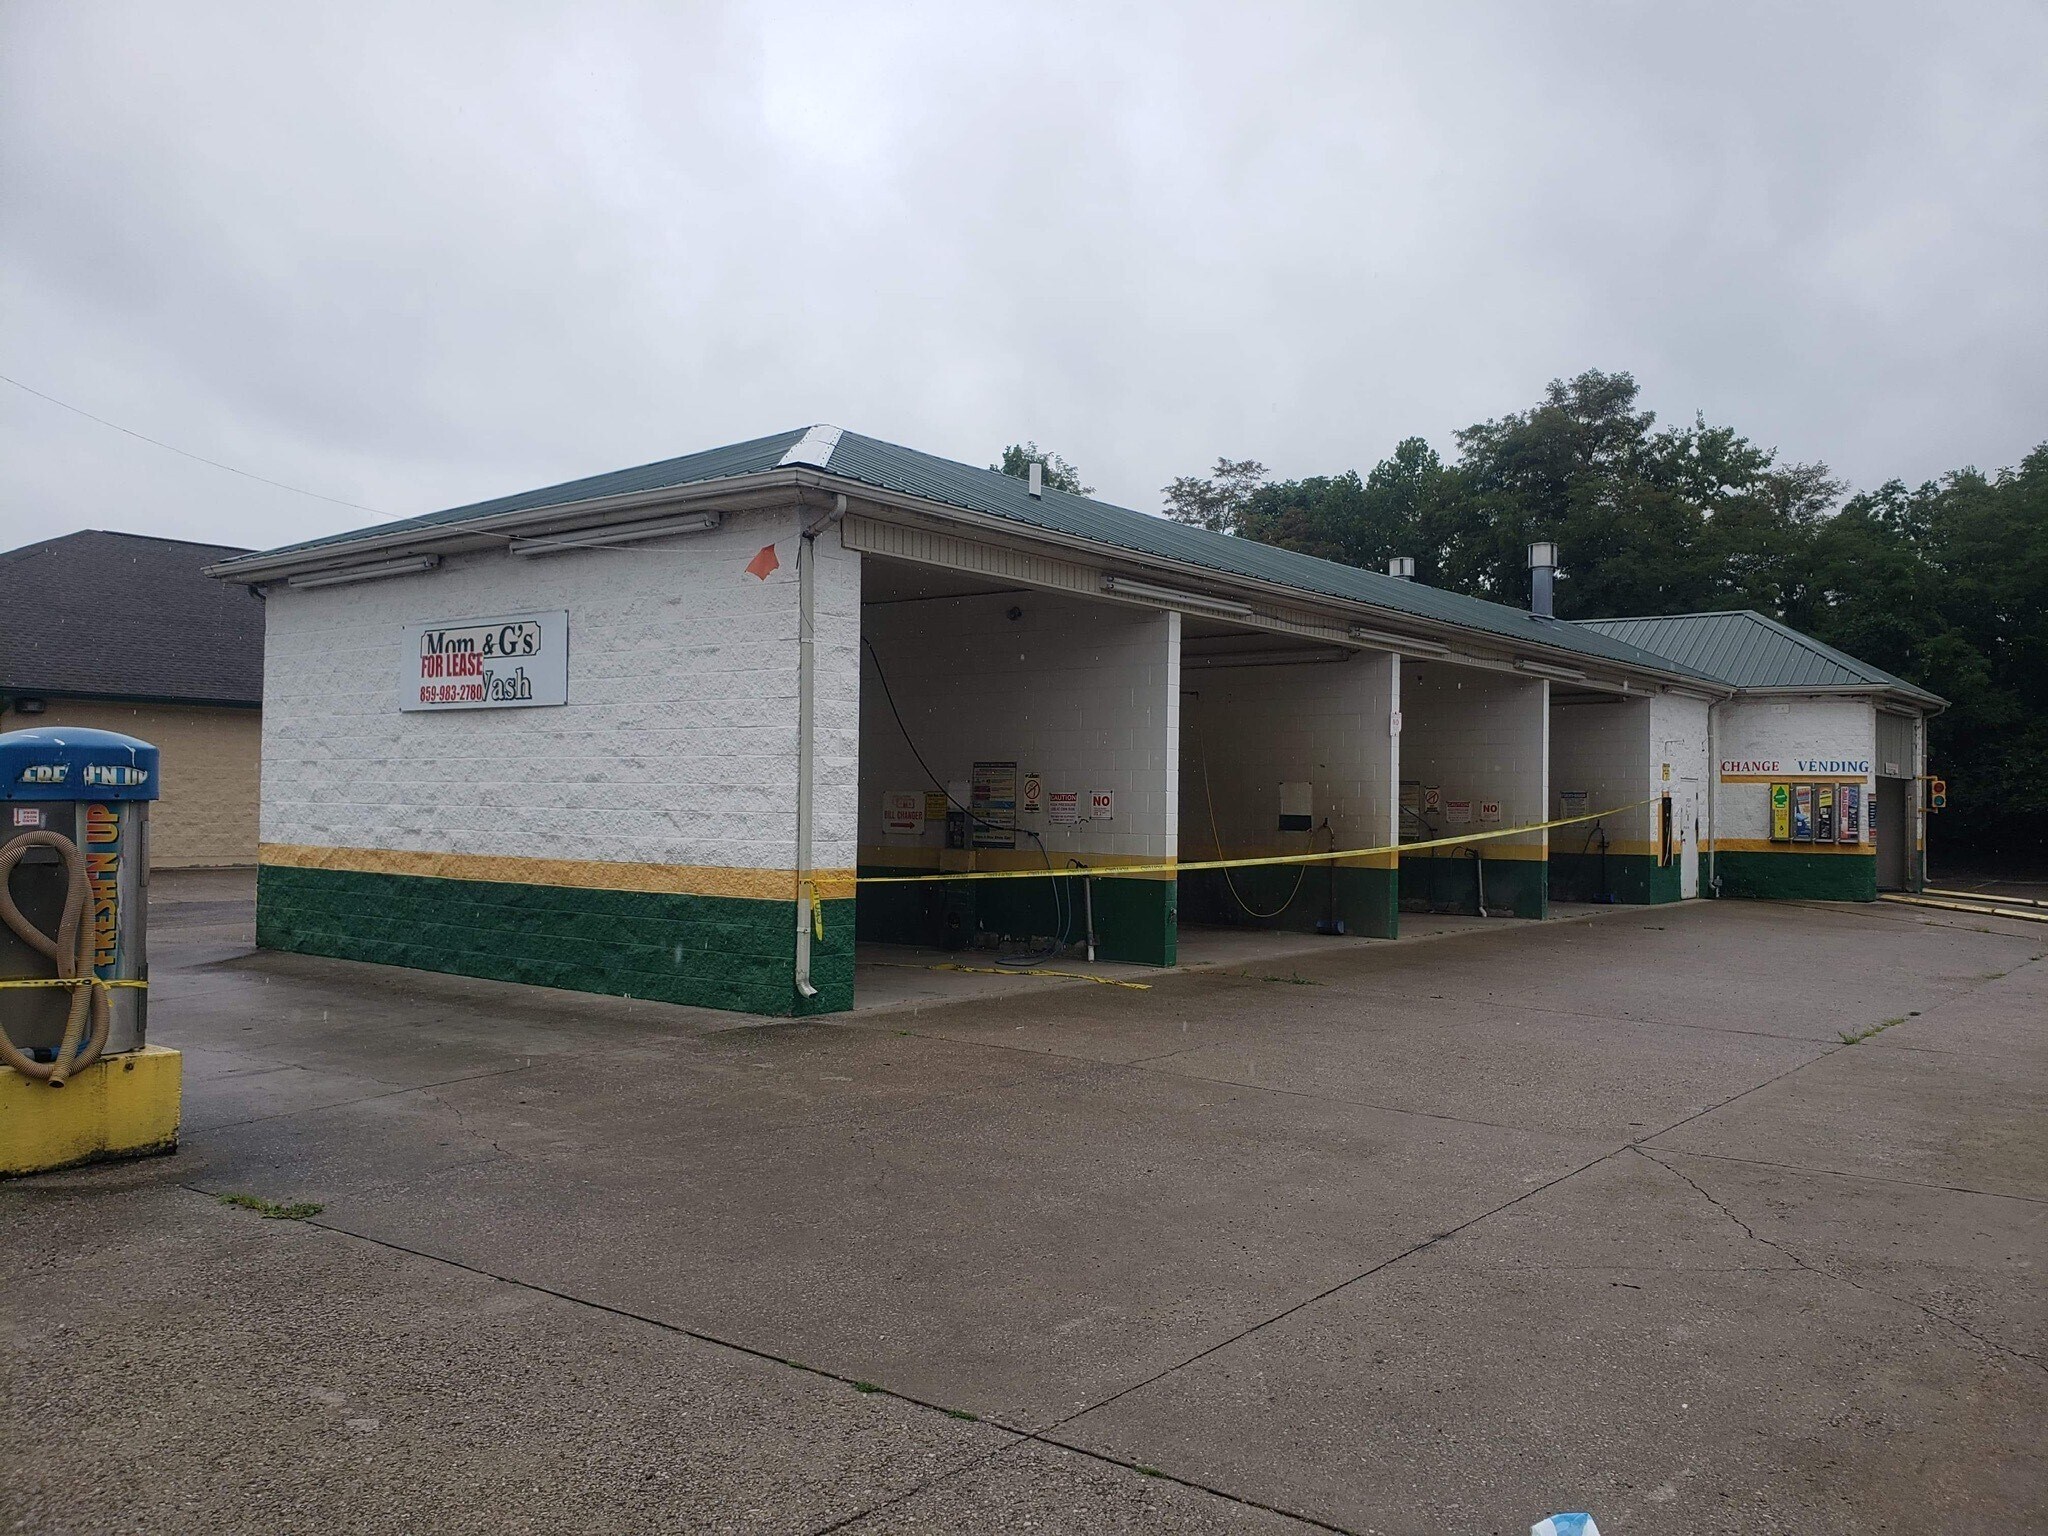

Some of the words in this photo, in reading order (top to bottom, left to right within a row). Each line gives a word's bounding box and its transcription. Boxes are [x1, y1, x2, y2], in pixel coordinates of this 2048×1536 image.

[427, 631, 474, 654] Mom
[483, 633, 494, 655] &
[499, 624, 534, 656] G's
[421, 654, 443, 678] FOR
[446, 652, 483, 677] LEASE
[420, 684, 483, 702] 859-983-2780
[1721, 760, 1780, 772] CHANGE
[1798, 760, 1869, 773] VENDING
[1093, 796, 1110, 806] NO
[884, 810, 895, 819] BILL
[897, 811, 923, 820] CHANGER
[1483, 804, 1497, 813] NO
[85, 803, 119, 844] UP
